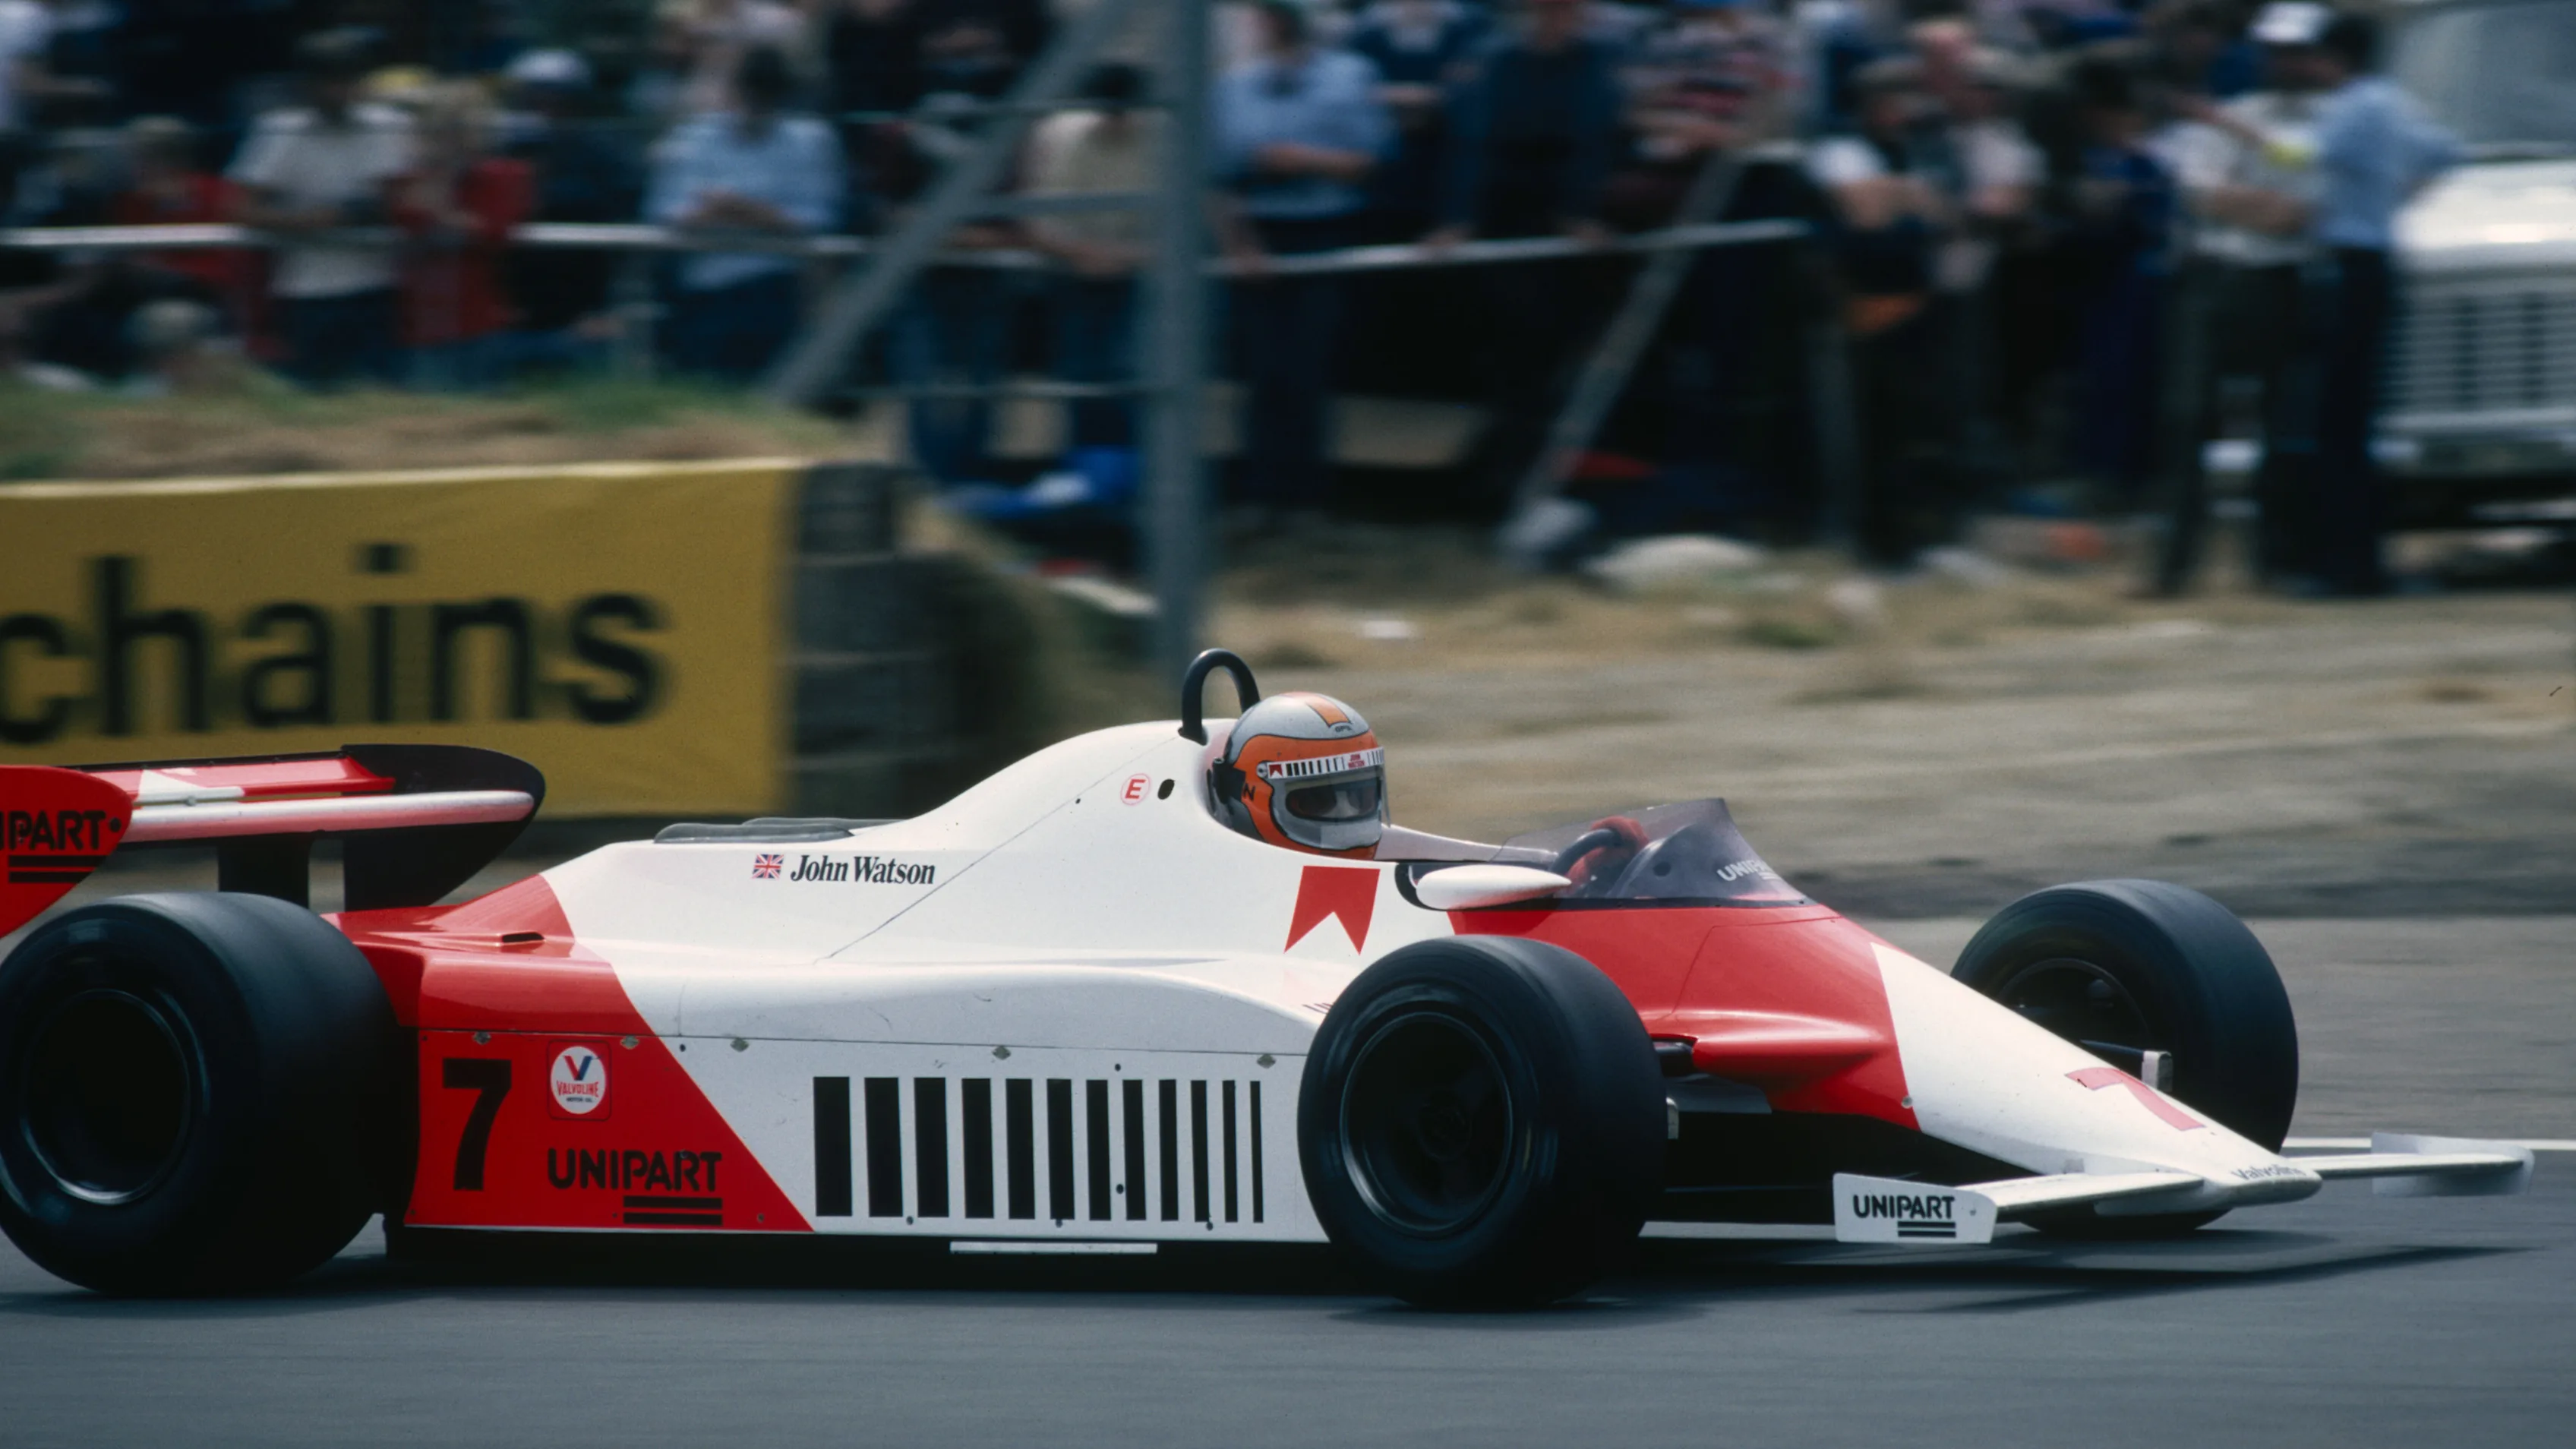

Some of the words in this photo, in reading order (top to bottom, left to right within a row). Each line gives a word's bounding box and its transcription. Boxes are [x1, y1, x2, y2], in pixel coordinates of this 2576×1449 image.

[0, 542, 668, 744] chains
[1125, 778, 1146, 799] E
[790, 854, 849, 882] John
[854, 856, 936, 885] Watson
[556, 1080, 599, 1098] VALVOLINE
[2064, 1066, 2206, 1132] 7
[442, 1058, 513, 1192] 7
[548, 1148, 722, 1192] UNIPART
[1852, 1194, 1956, 1220] UNIPART
